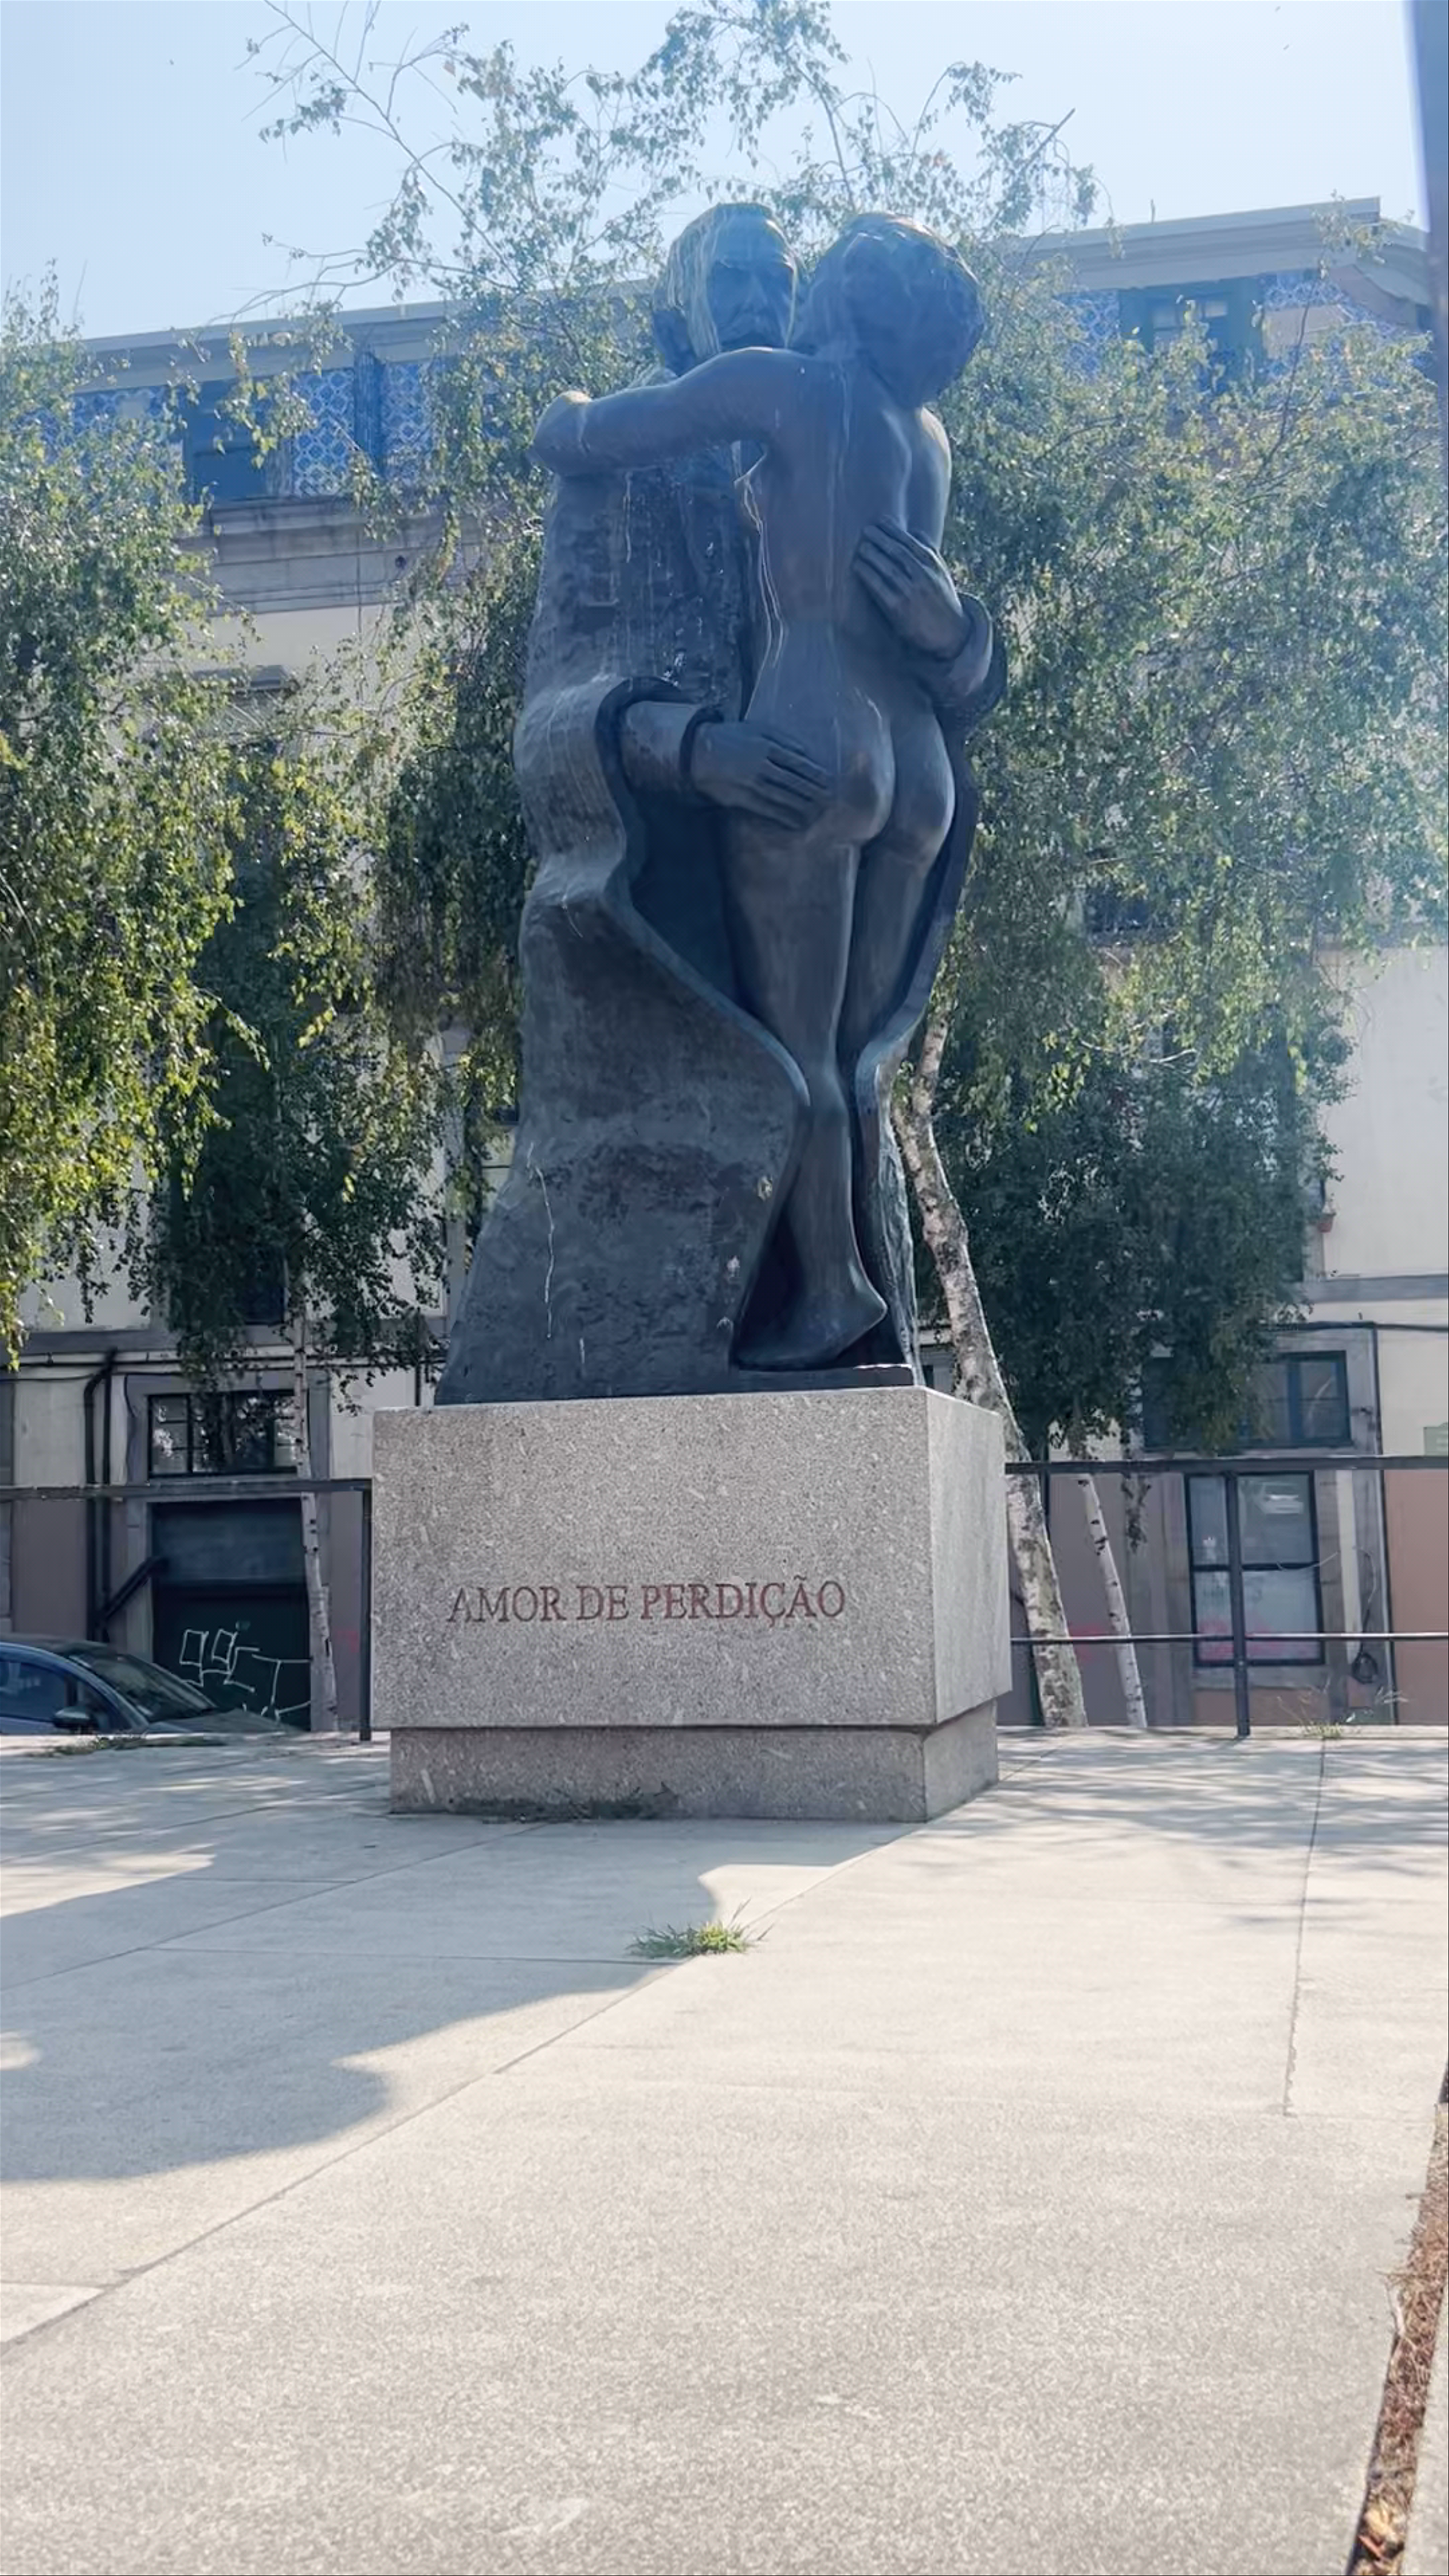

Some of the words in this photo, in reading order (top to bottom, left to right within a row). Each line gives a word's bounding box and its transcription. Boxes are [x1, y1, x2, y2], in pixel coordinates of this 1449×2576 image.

[446, 1586, 567, 1622] AMOR
[576, 1585, 629, 1621] DE
[640, 1575, 845, 1628] PERDIÇÃO
